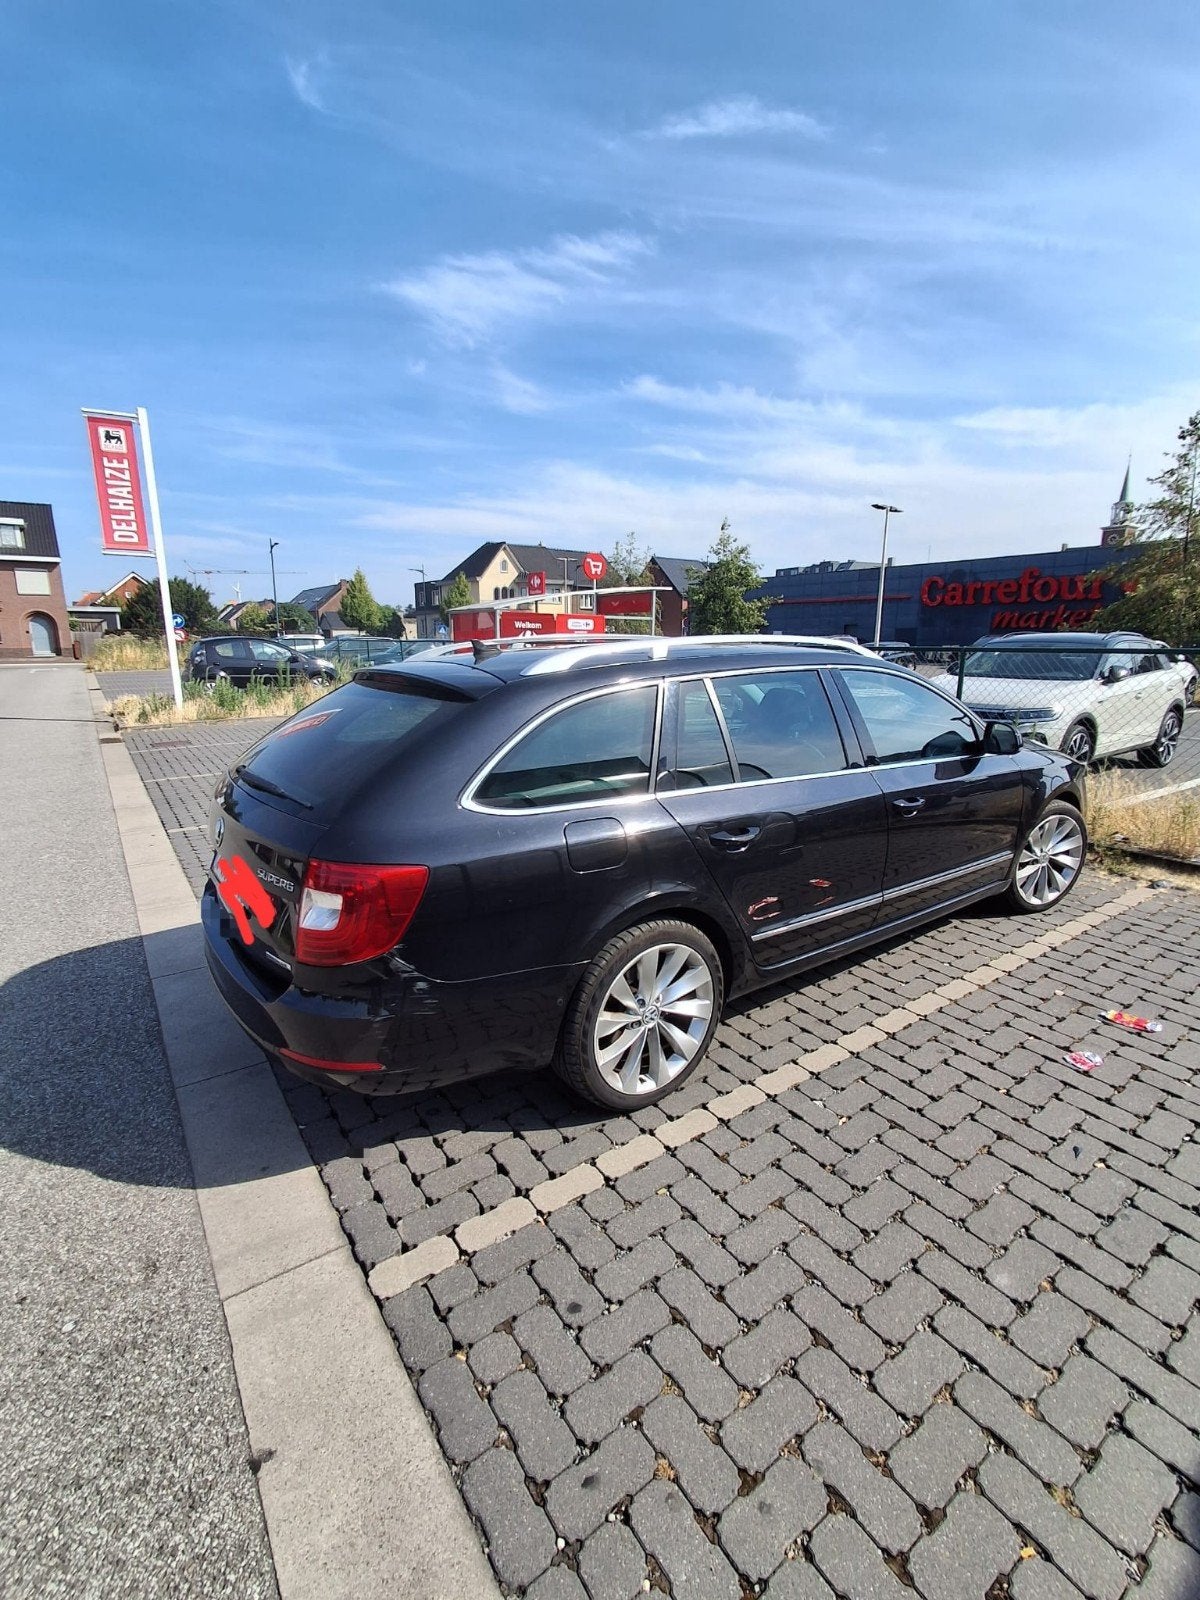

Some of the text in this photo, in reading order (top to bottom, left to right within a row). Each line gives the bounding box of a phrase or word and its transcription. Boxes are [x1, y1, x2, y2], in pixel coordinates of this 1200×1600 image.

[103, 457, 139, 543] DELHAIZE
[921, 567, 1106, 607] Carrefour
[514, 620, 542, 629] Welkom
